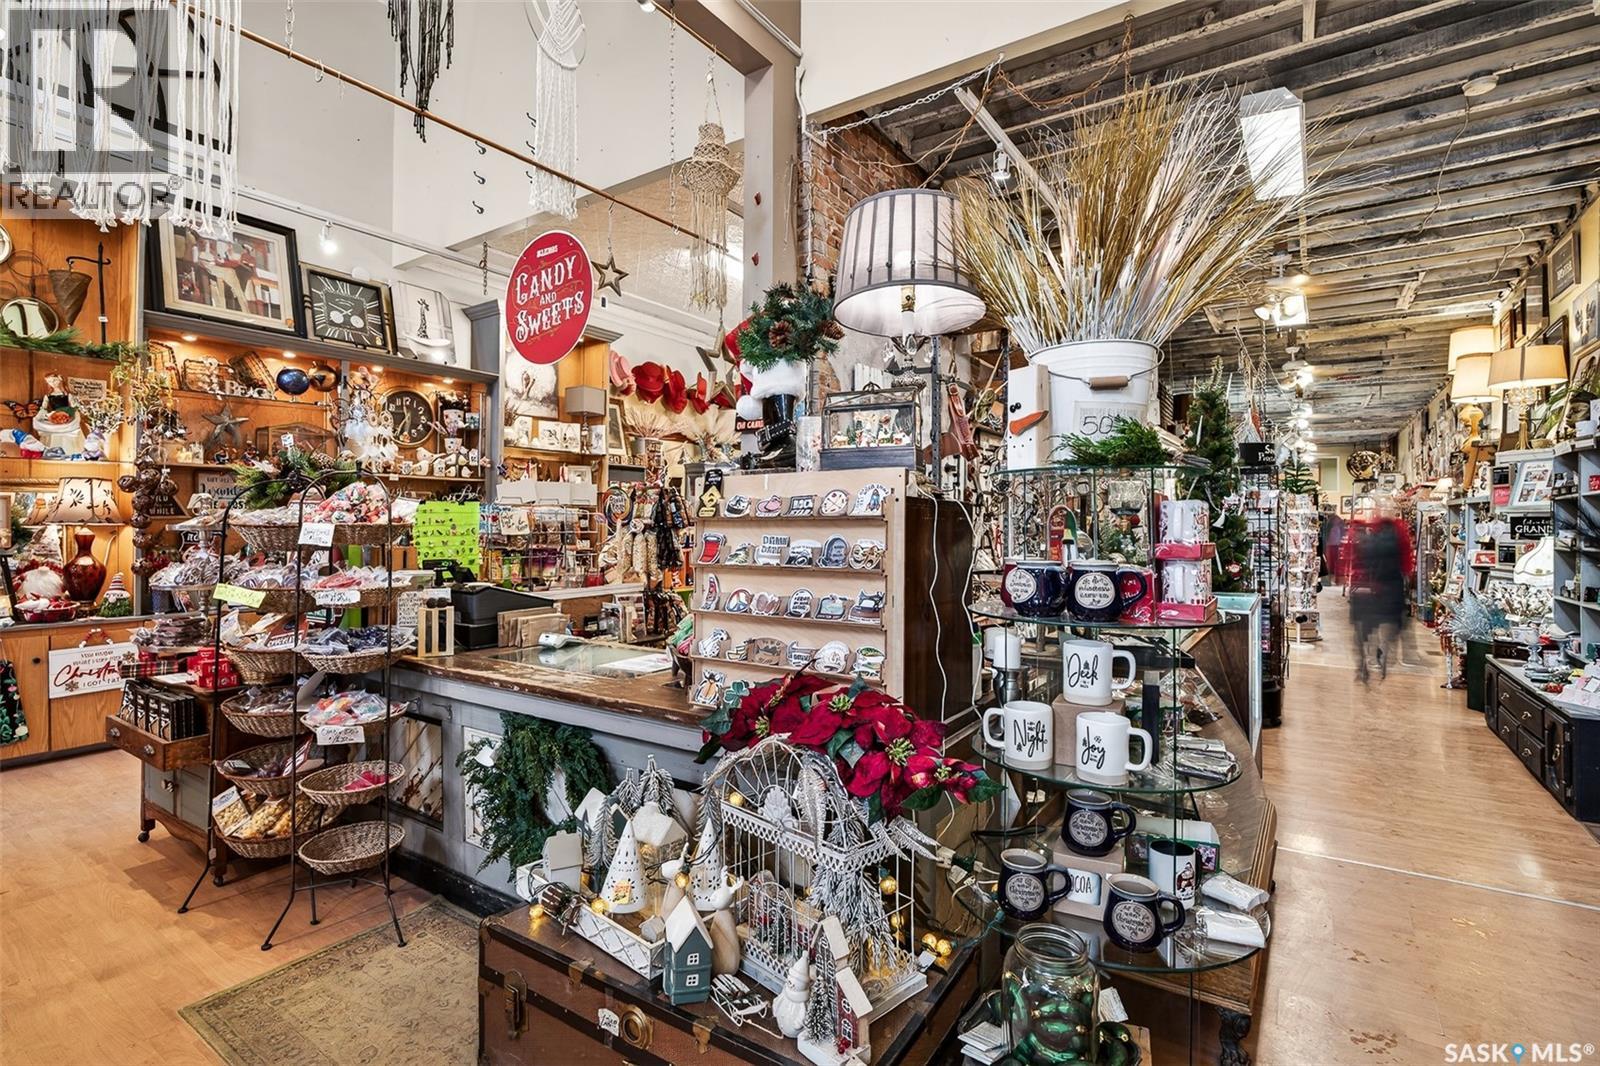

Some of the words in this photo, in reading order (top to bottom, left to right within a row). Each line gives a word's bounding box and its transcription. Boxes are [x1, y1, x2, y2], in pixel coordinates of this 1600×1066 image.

[515, 255, 577, 306] CANDY
[540, 291, 557, 306] AND
[515, 290, 585, 343] SWEETS
[1066, 653, 1099, 687] Deck
[1013, 719, 1047, 758] Night
[1081, 725, 1106, 770] Joy
